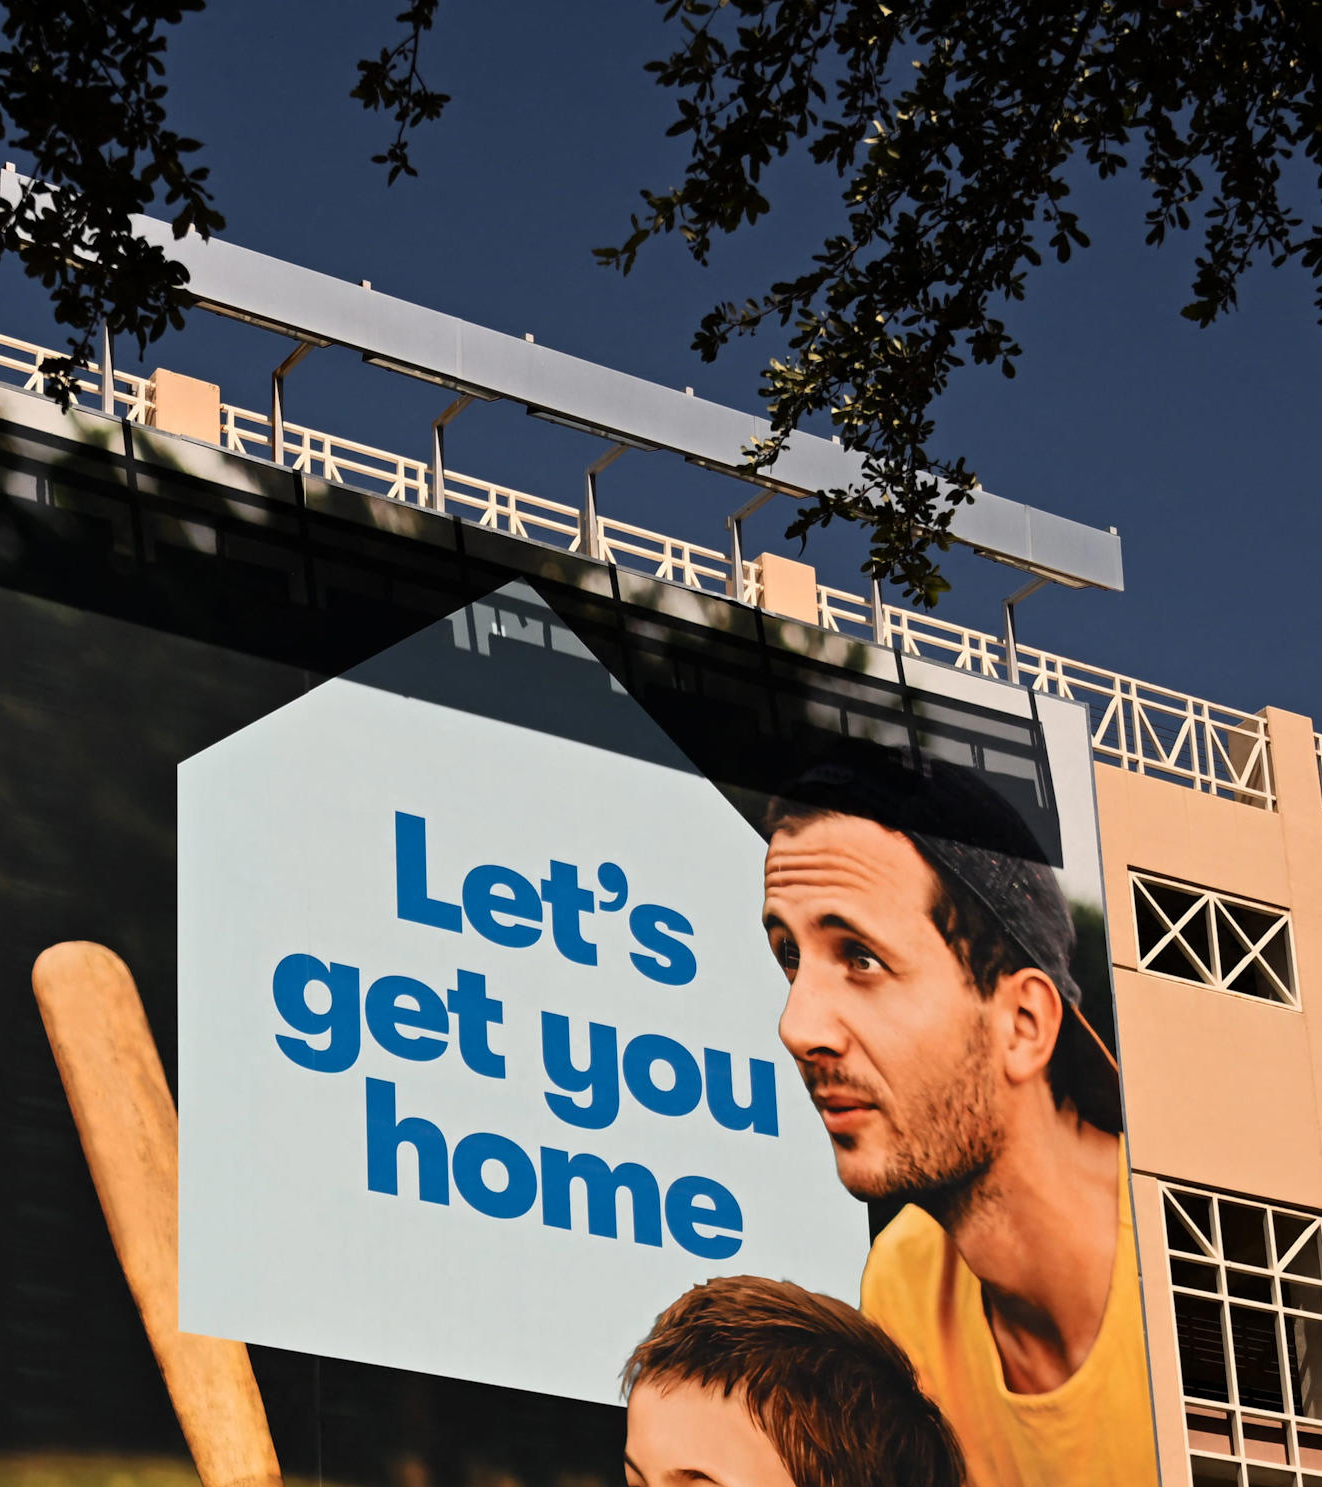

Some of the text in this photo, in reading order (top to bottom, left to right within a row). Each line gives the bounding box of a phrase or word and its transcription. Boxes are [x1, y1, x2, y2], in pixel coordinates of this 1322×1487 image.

[395, 810, 697, 986] Let’s
[272, 953, 779, 1138] get you
[365, 1076, 744, 1260] home
